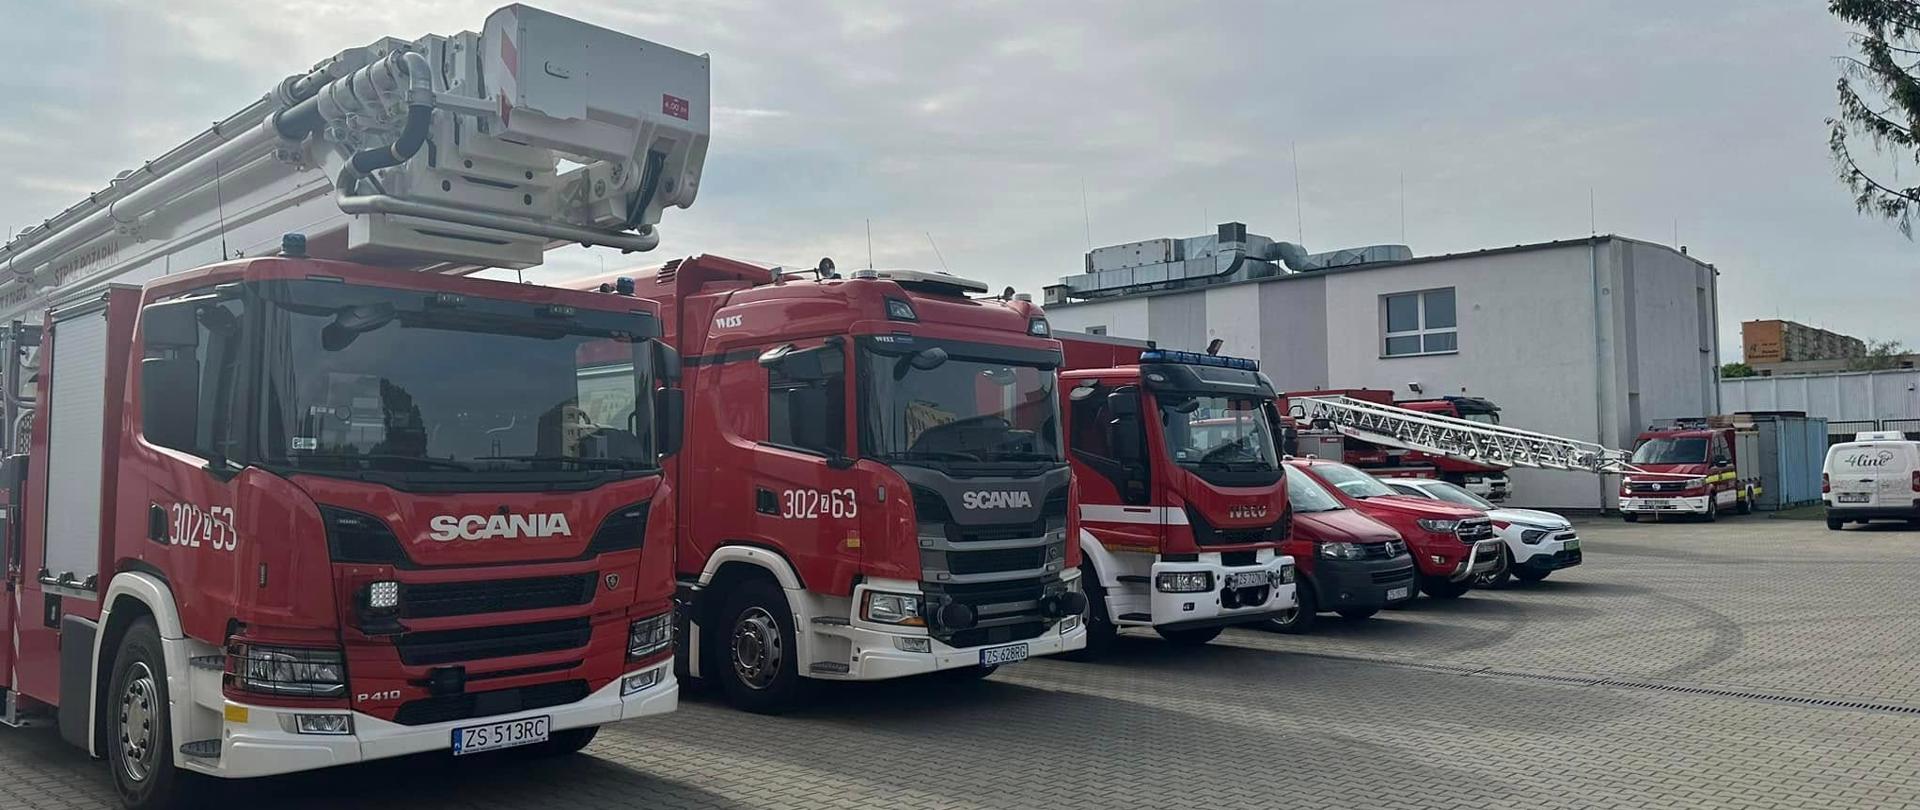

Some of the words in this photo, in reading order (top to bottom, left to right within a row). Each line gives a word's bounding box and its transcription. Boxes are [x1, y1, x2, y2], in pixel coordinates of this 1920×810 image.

[716, 314, 743, 329] WISS
[963, 490, 1033, 510] SCANIA
[1230, 504, 1267, 519] IVECO
[429, 513, 572, 542] SCANIA
[986, 649, 998, 664] ZS
[1000, 645, 1026, 662] 628RG
[357, 693, 369, 703] P
[370, 690, 401, 701] 410
[465, 728, 488, 748] ZS
[494, 720, 545, 744] 513RC
